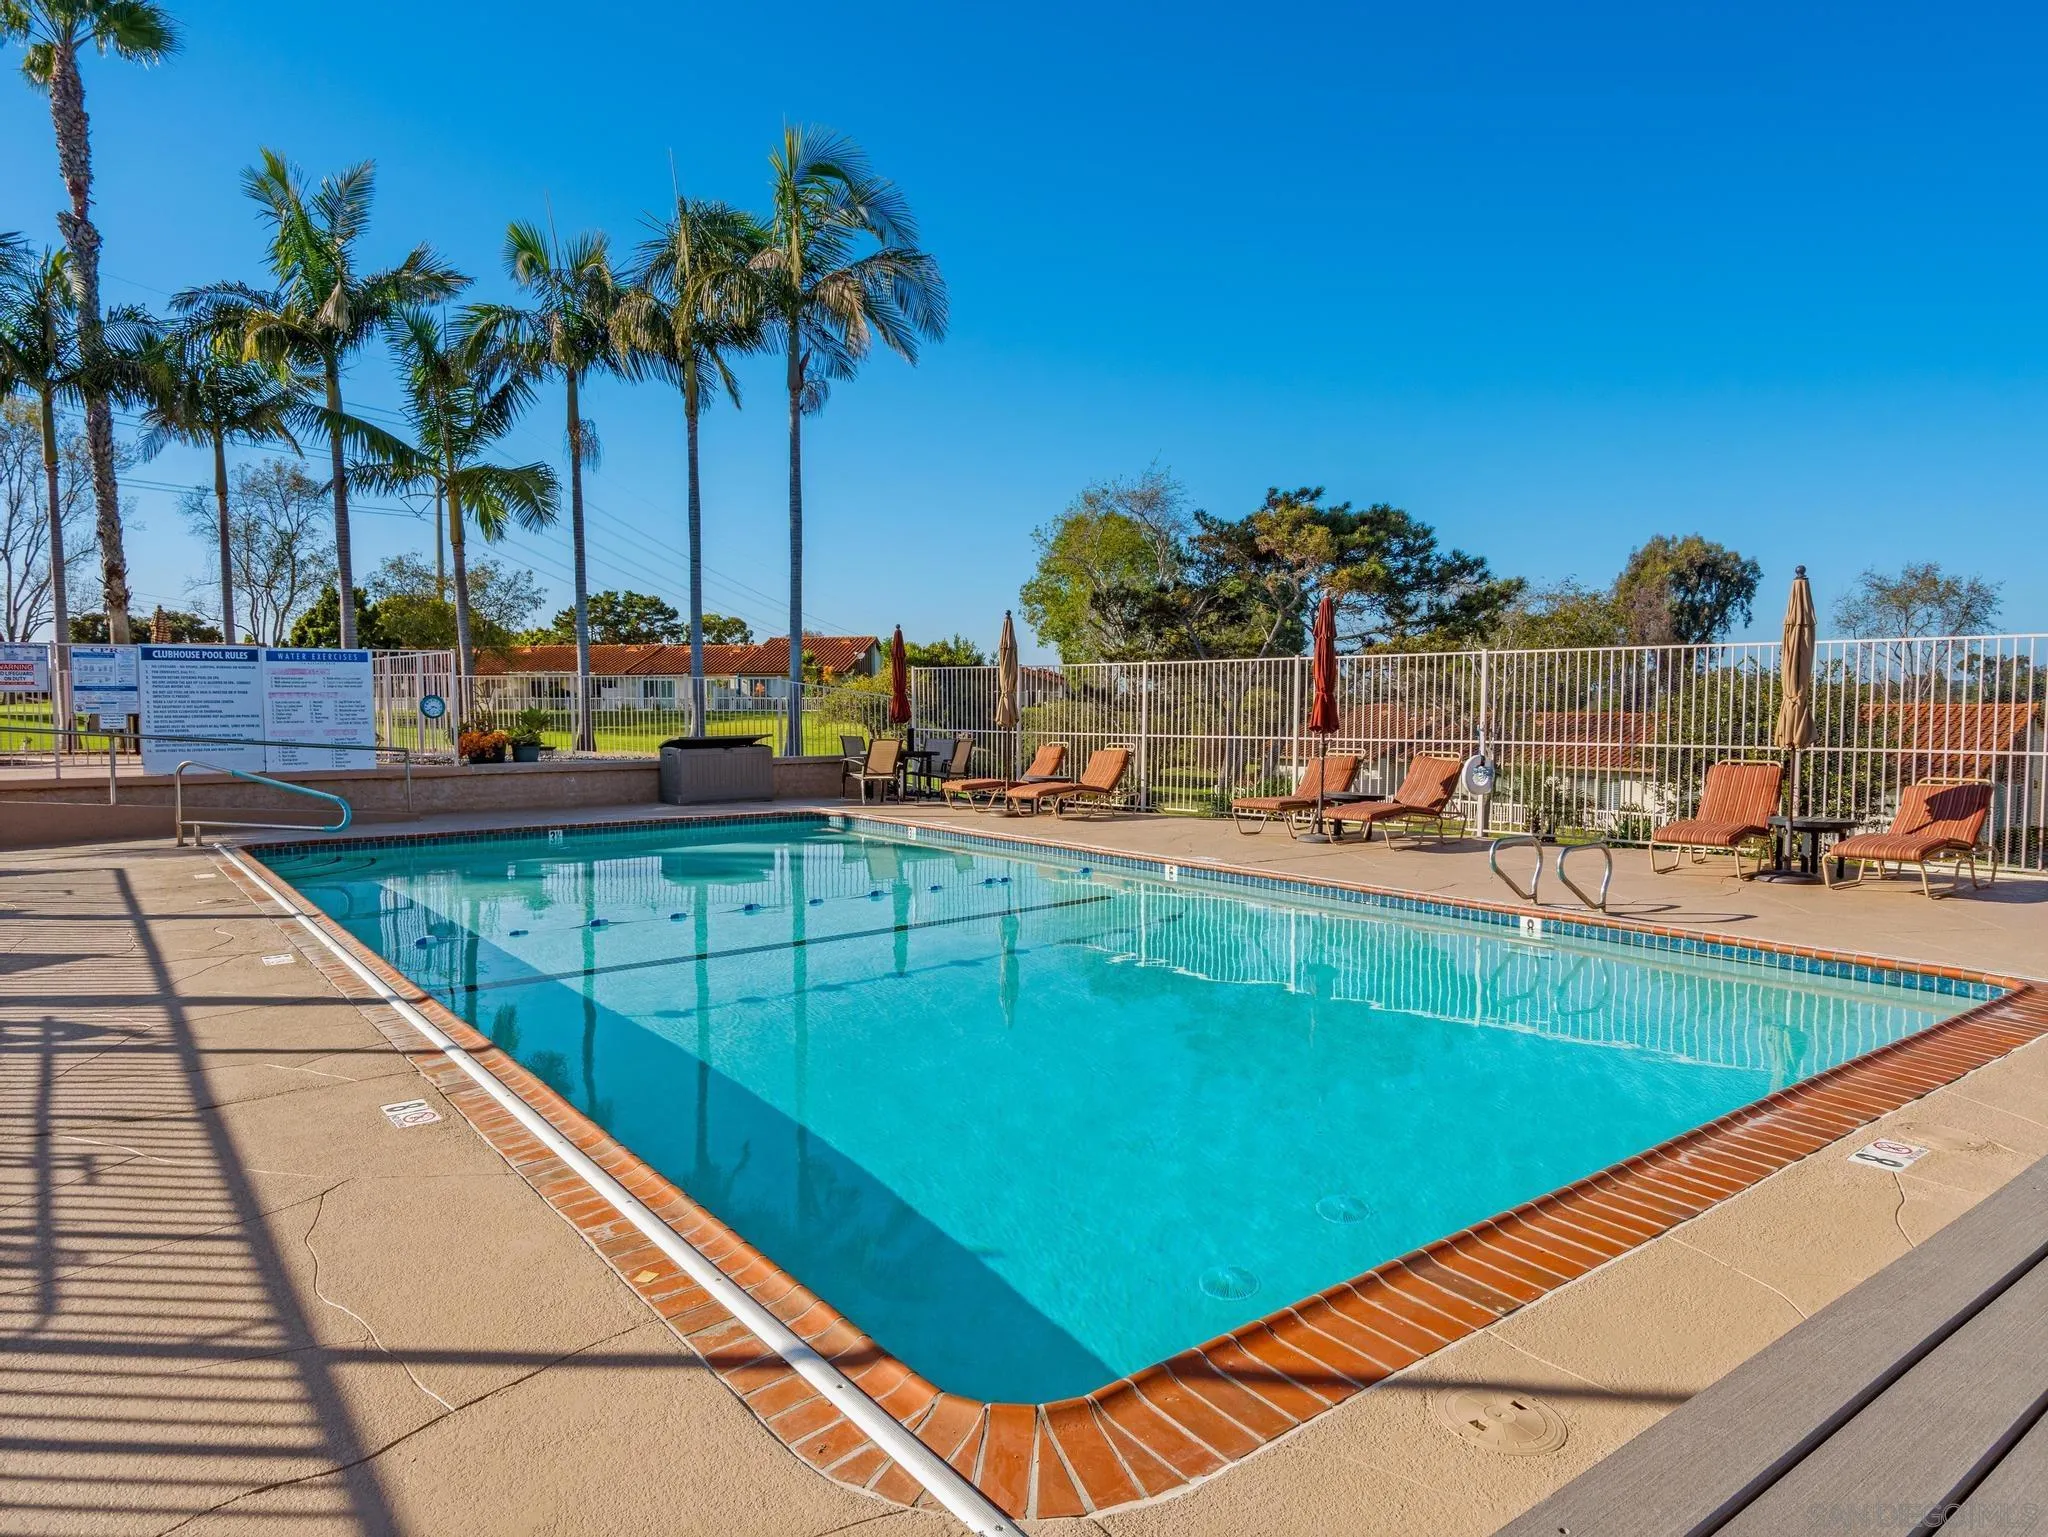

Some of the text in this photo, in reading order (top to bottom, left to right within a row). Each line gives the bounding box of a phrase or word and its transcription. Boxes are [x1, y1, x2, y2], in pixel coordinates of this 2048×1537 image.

[152, 650, 248, 660] CLUBHOUSE POOL RULES
[277, 652, 358, 661] WATER EXERCISES
